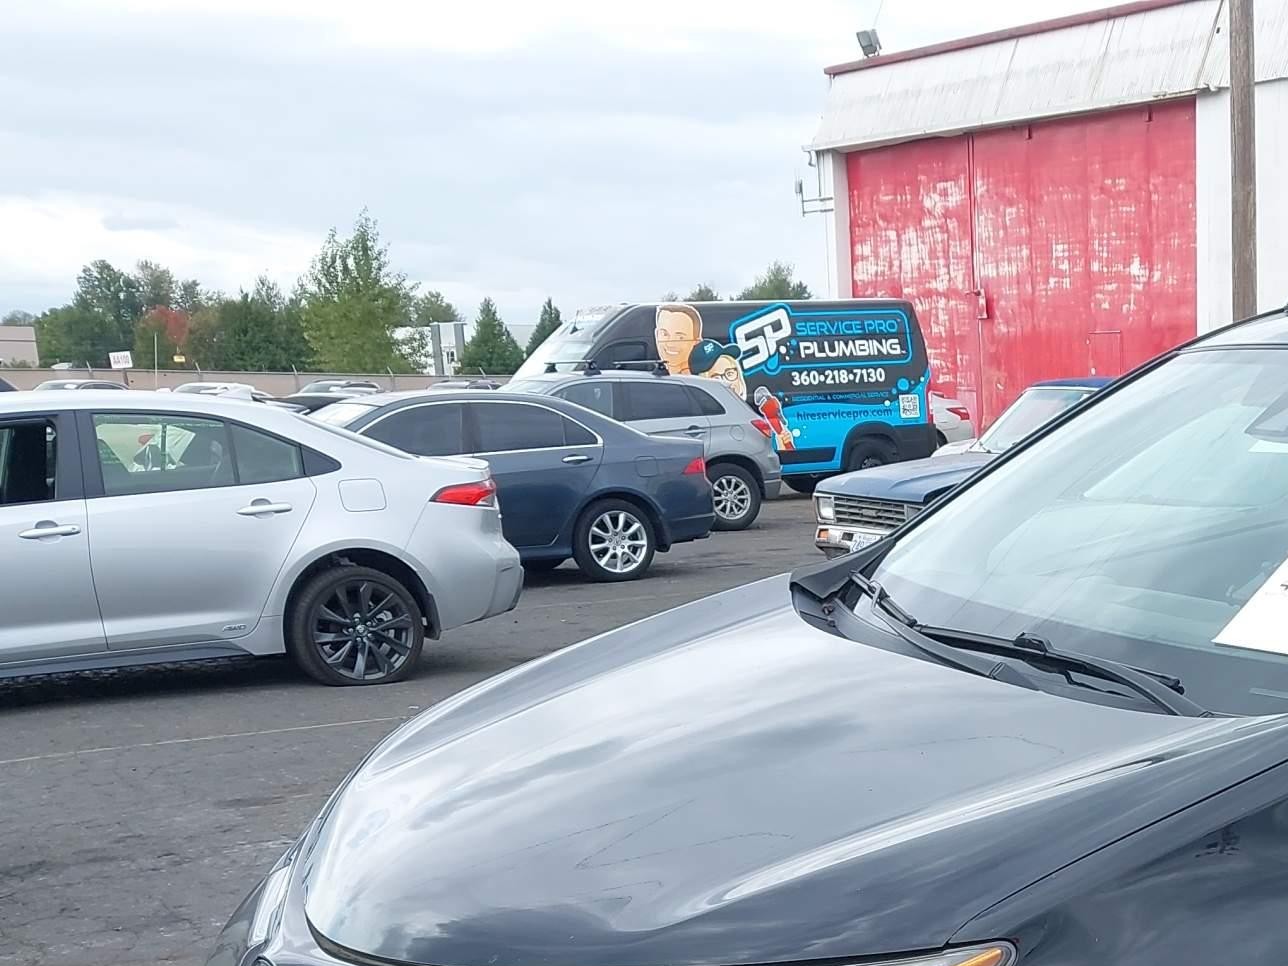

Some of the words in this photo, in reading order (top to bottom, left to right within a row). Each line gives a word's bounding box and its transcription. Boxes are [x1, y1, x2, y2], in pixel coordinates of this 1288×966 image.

[795, 320, 864, 336] SERVICE
[864, 319, 898, 334] PRO
[735, 308, 791, 370] SP
[799, 338, 901, 358] PLUMBING
[797, 408, 893, 421] hireservicepro.com
